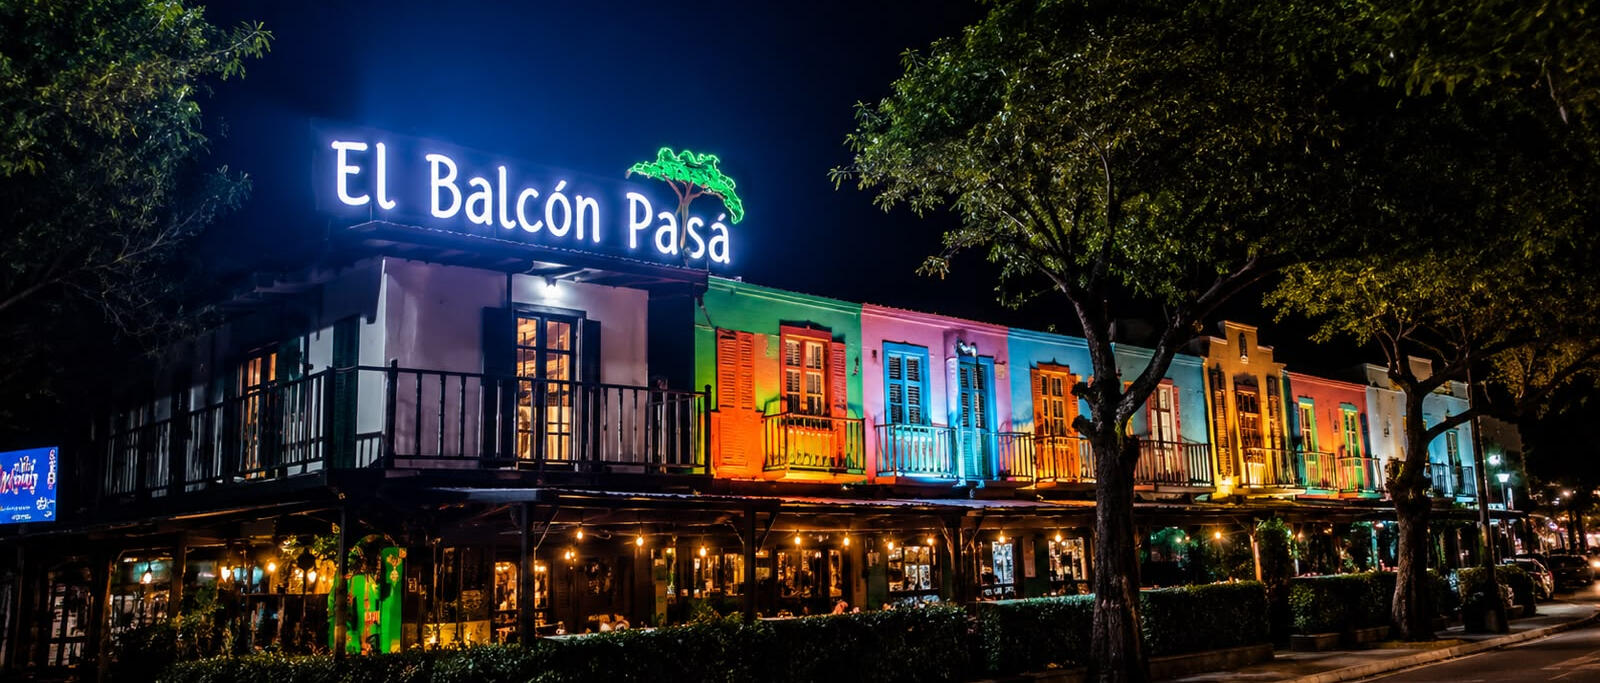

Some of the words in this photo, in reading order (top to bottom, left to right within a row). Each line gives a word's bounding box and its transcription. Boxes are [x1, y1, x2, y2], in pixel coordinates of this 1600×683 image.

[331, 140, 396, 210] El
[425, 153, 601, 243] Balcón
[626, 191, 731, 264] Pasá
